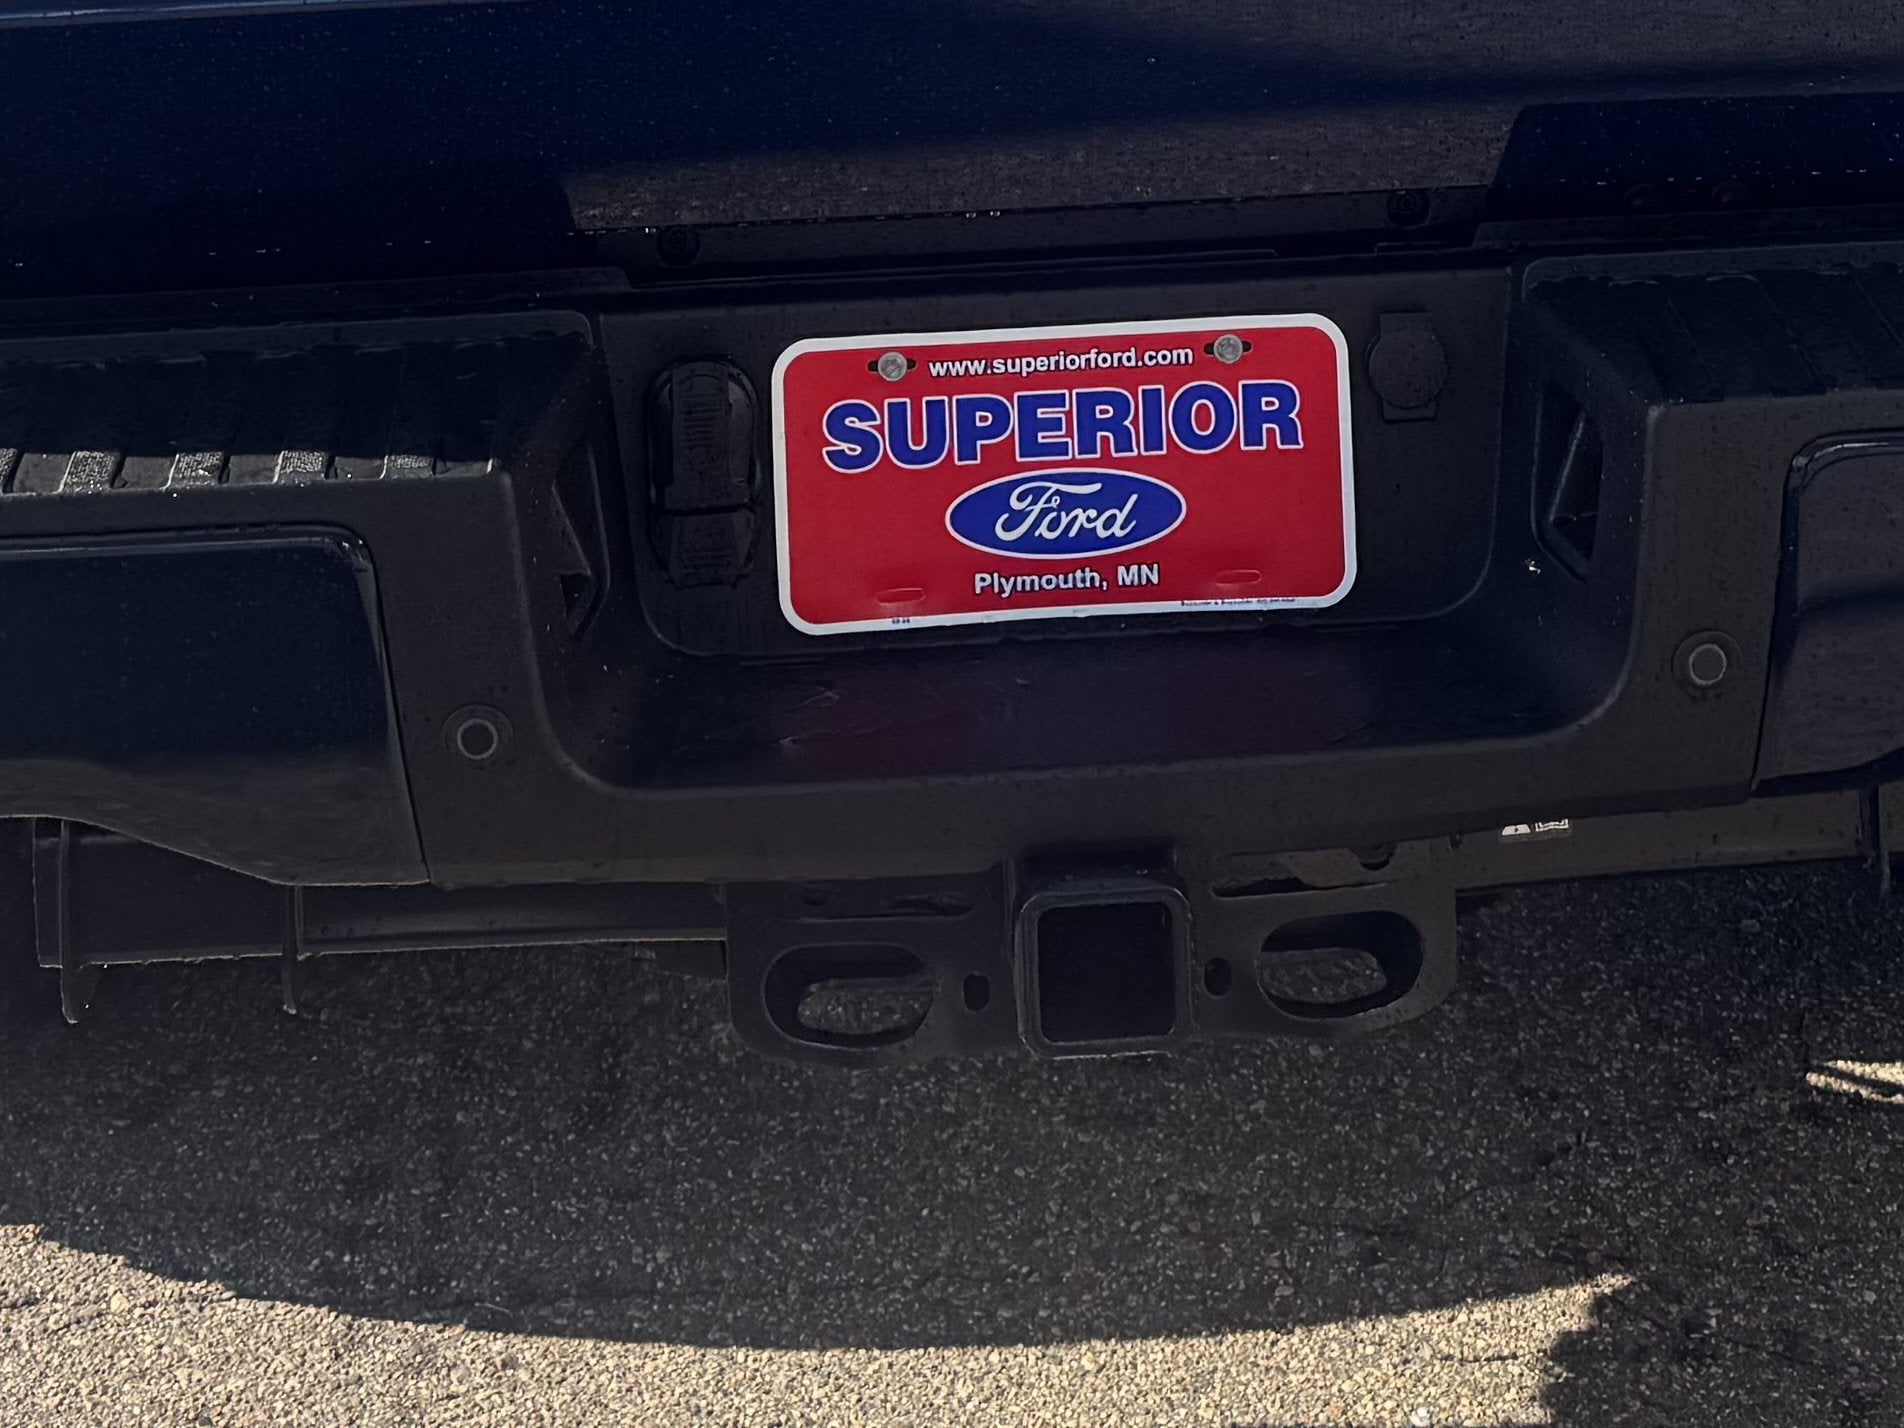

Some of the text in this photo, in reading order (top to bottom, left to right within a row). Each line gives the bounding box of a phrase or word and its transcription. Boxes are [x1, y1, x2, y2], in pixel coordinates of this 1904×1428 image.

[927, 345, 1194, 379] www.superiorford.com
[821, 379, 1304, 474] SUPERIOR
[994, 481, 1137, 542] Ford
[973, 563, 1161, 600] Plymouth, MN
